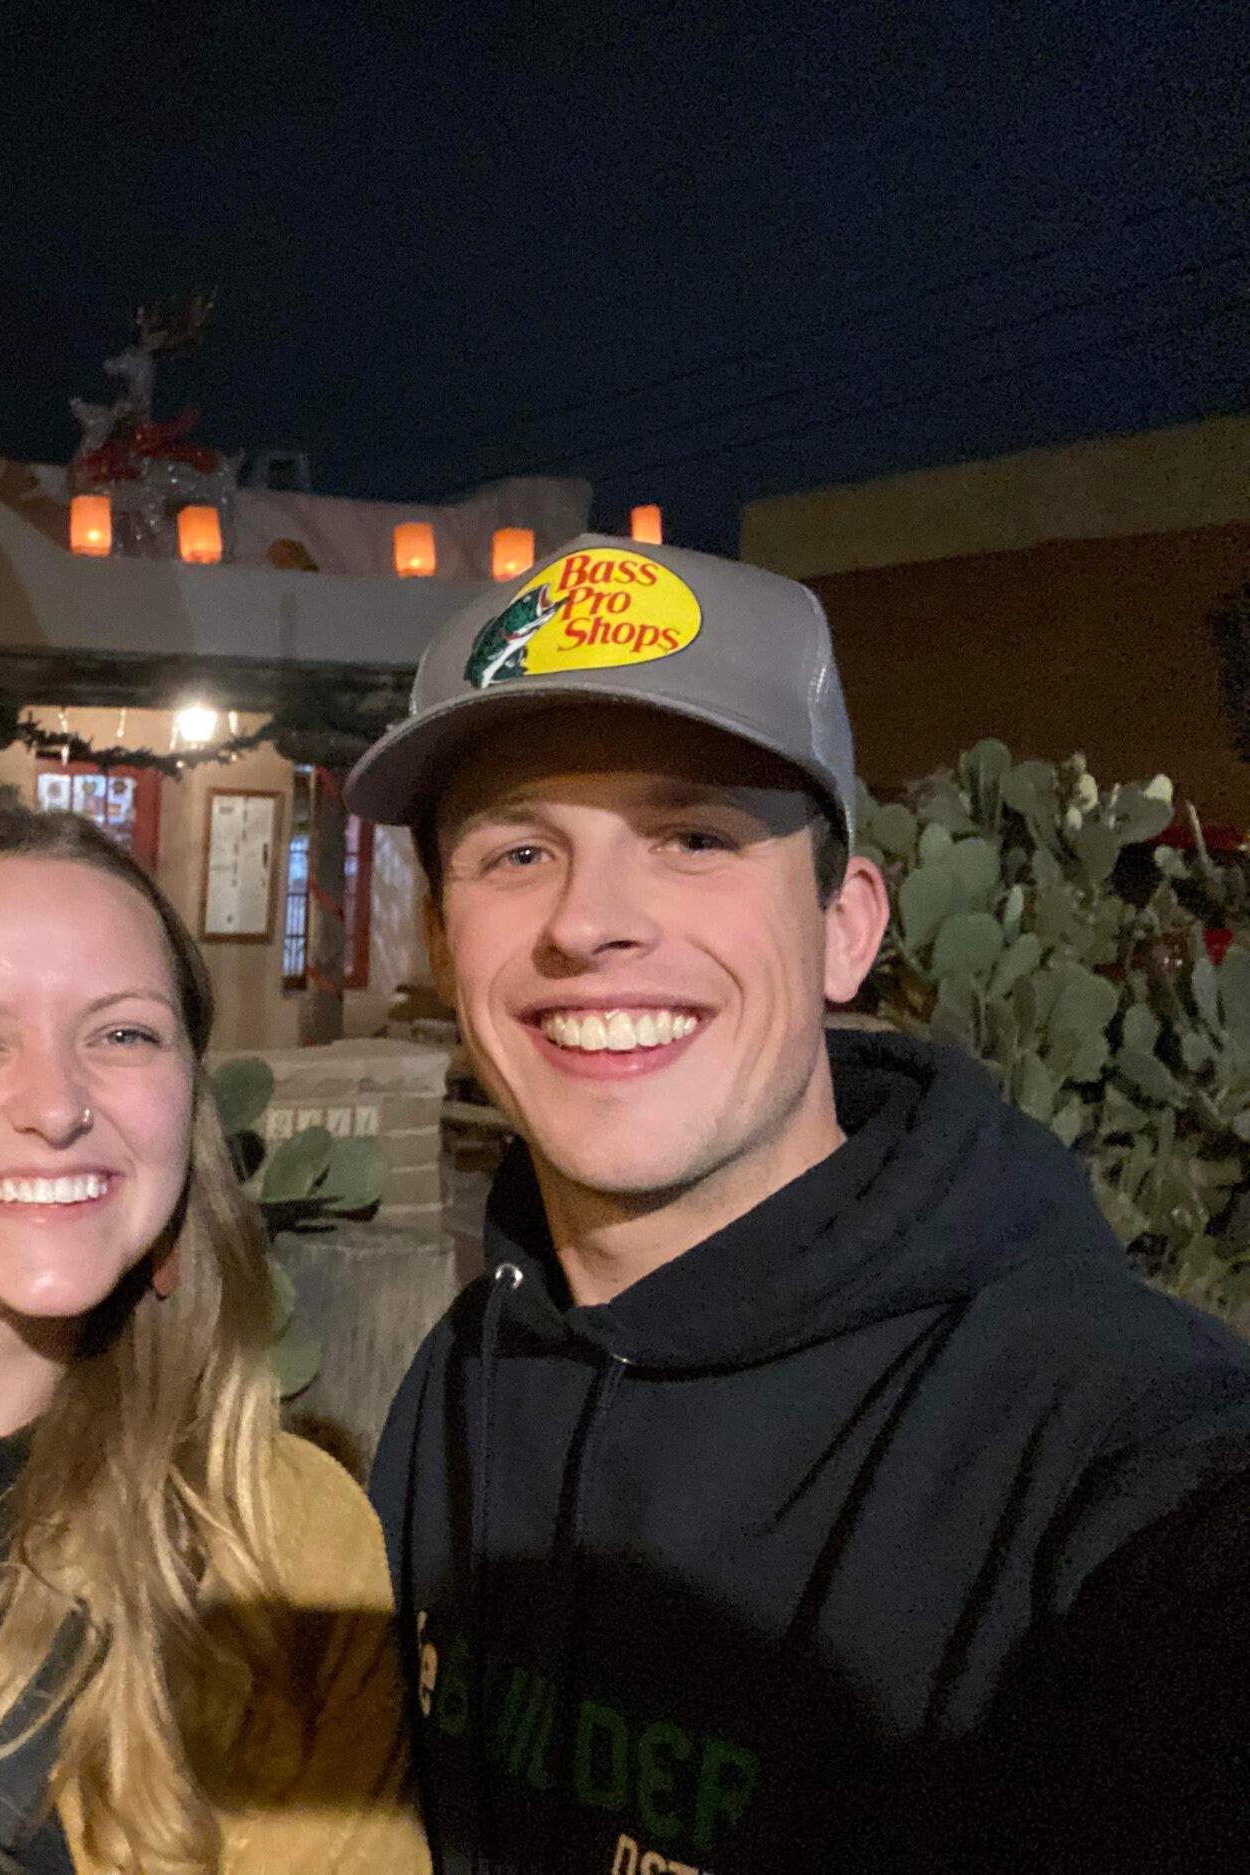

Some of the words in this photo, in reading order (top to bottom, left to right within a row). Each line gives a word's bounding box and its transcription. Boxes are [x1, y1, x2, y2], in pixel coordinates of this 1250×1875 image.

[558, 555, 659, 592] Bass
[561, 586, 632, 621] Pro
[557, 617, 681, 653] Shops
